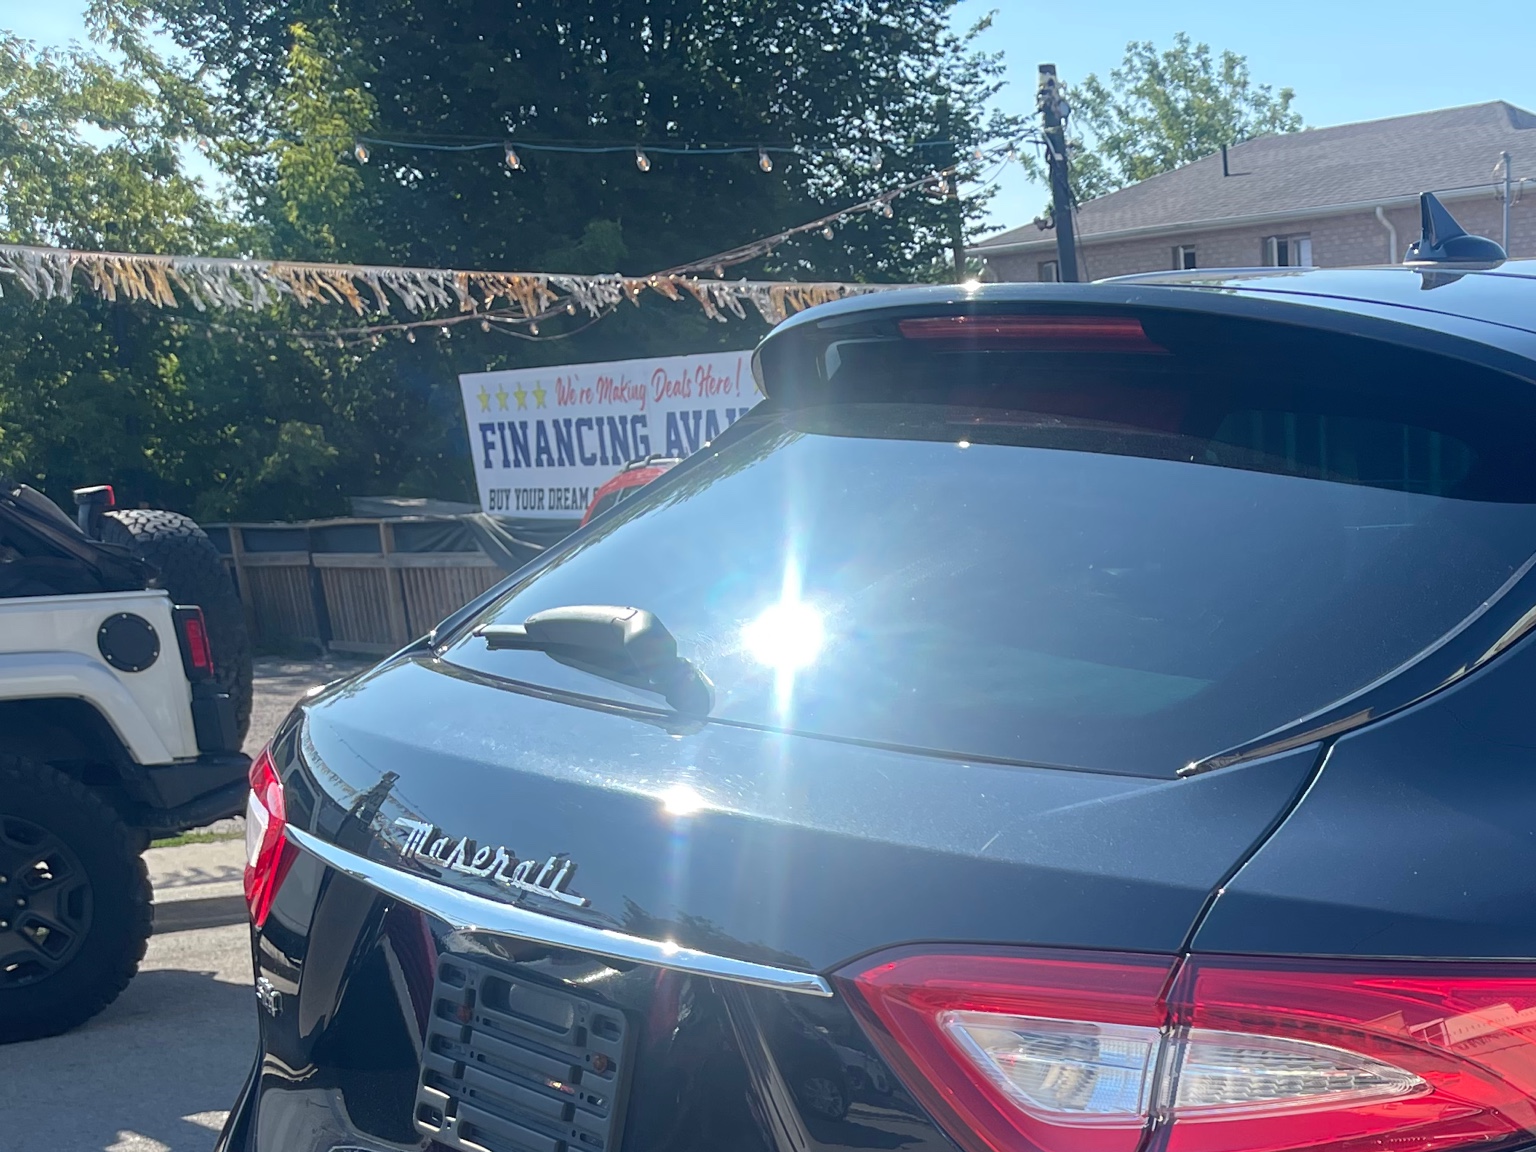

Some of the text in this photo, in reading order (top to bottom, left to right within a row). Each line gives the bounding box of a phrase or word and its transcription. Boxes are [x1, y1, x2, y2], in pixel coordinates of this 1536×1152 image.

[555, 374, 594, 407] We're
[597, 374, 647, 411] Making
[651, 367, 692, 403] Deals
[478, 414, 650, 470] FINANCING
[488, 488, 512, 511] BUY
[514, 487, 545, 511] YOUR
[548, 487, 590, 511] DREAM
[394, 817, 588, 907] Maserati
